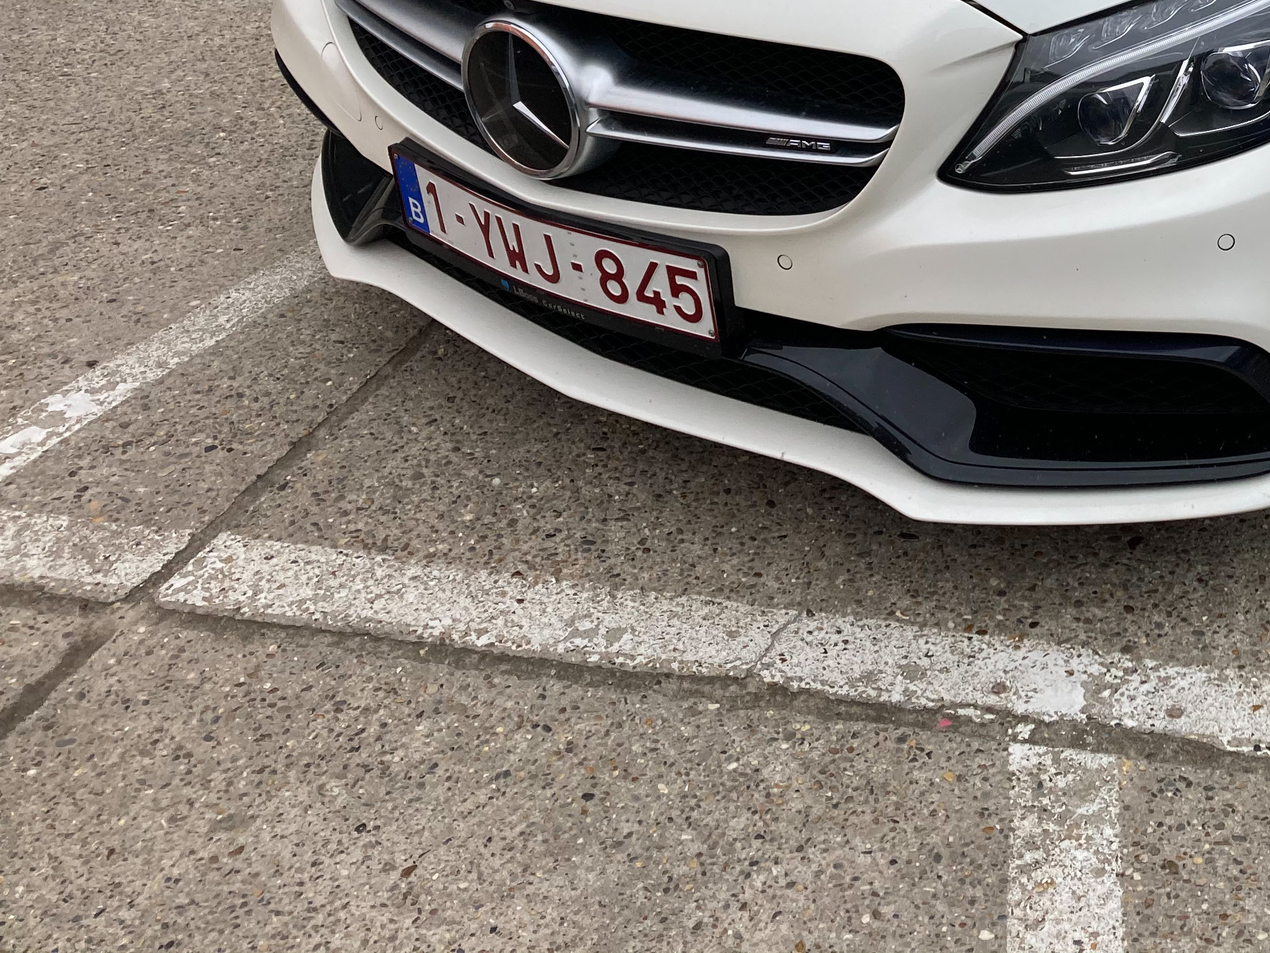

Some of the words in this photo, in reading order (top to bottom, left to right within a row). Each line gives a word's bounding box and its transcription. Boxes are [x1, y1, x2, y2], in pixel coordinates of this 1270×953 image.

[786, 139, 831, 151] AMG
[407, 197, 425, 224] B
[426, 180, 704, 324] 1-YWJ-845
